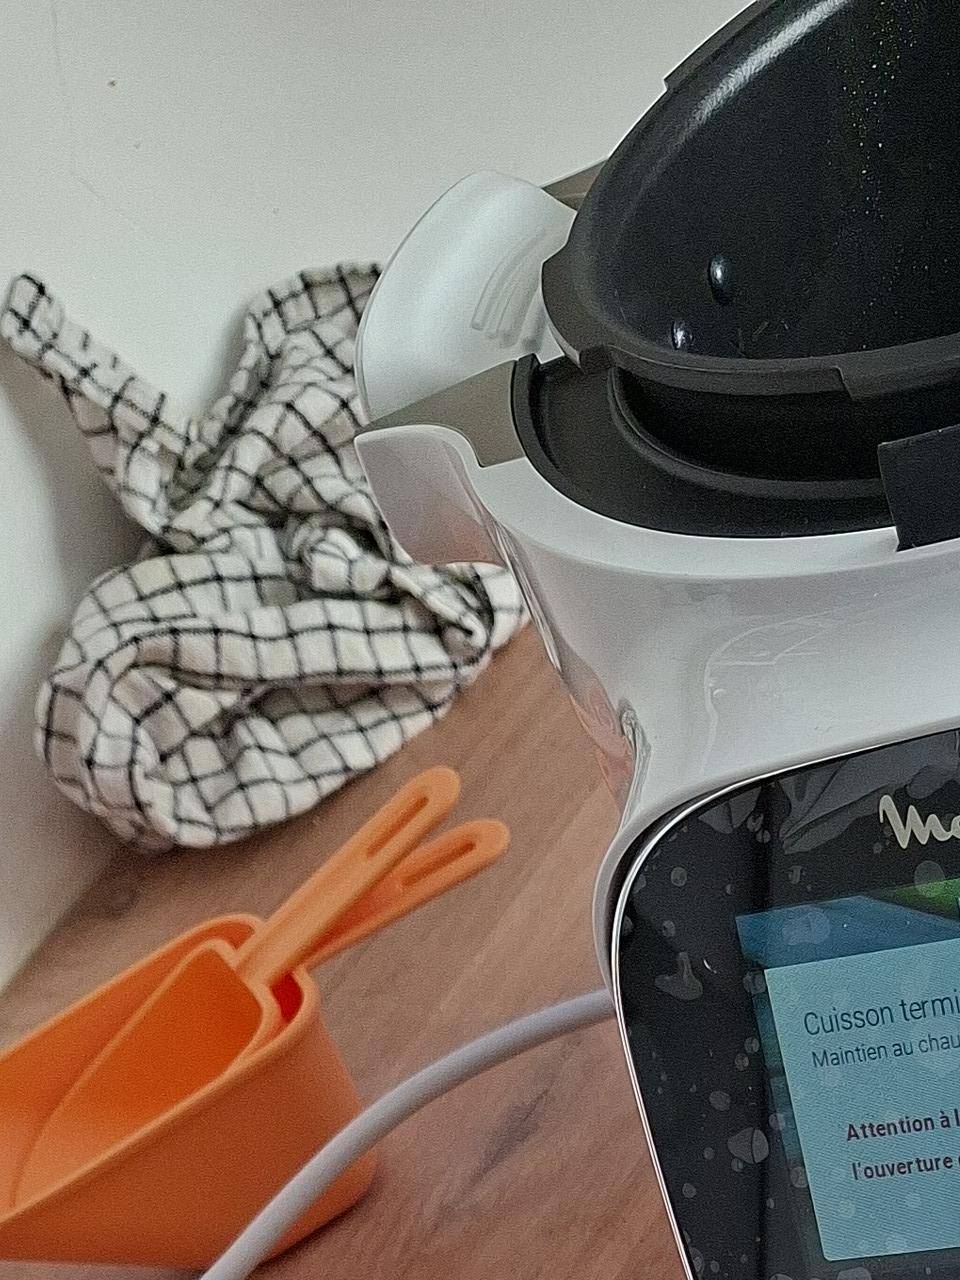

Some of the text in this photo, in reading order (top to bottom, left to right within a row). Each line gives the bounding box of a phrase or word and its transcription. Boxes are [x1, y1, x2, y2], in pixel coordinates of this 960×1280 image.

[804, 1005, 894, 1036] Cuisson
[811, 1043, 889, 1068] Maintien
[893, 1041, 914, 1057] au
[846, 1115, 935, 1142] Attention
[940, 1111, 951, 1129] à
[851, 1154, 953, 1180] l'ouverture
